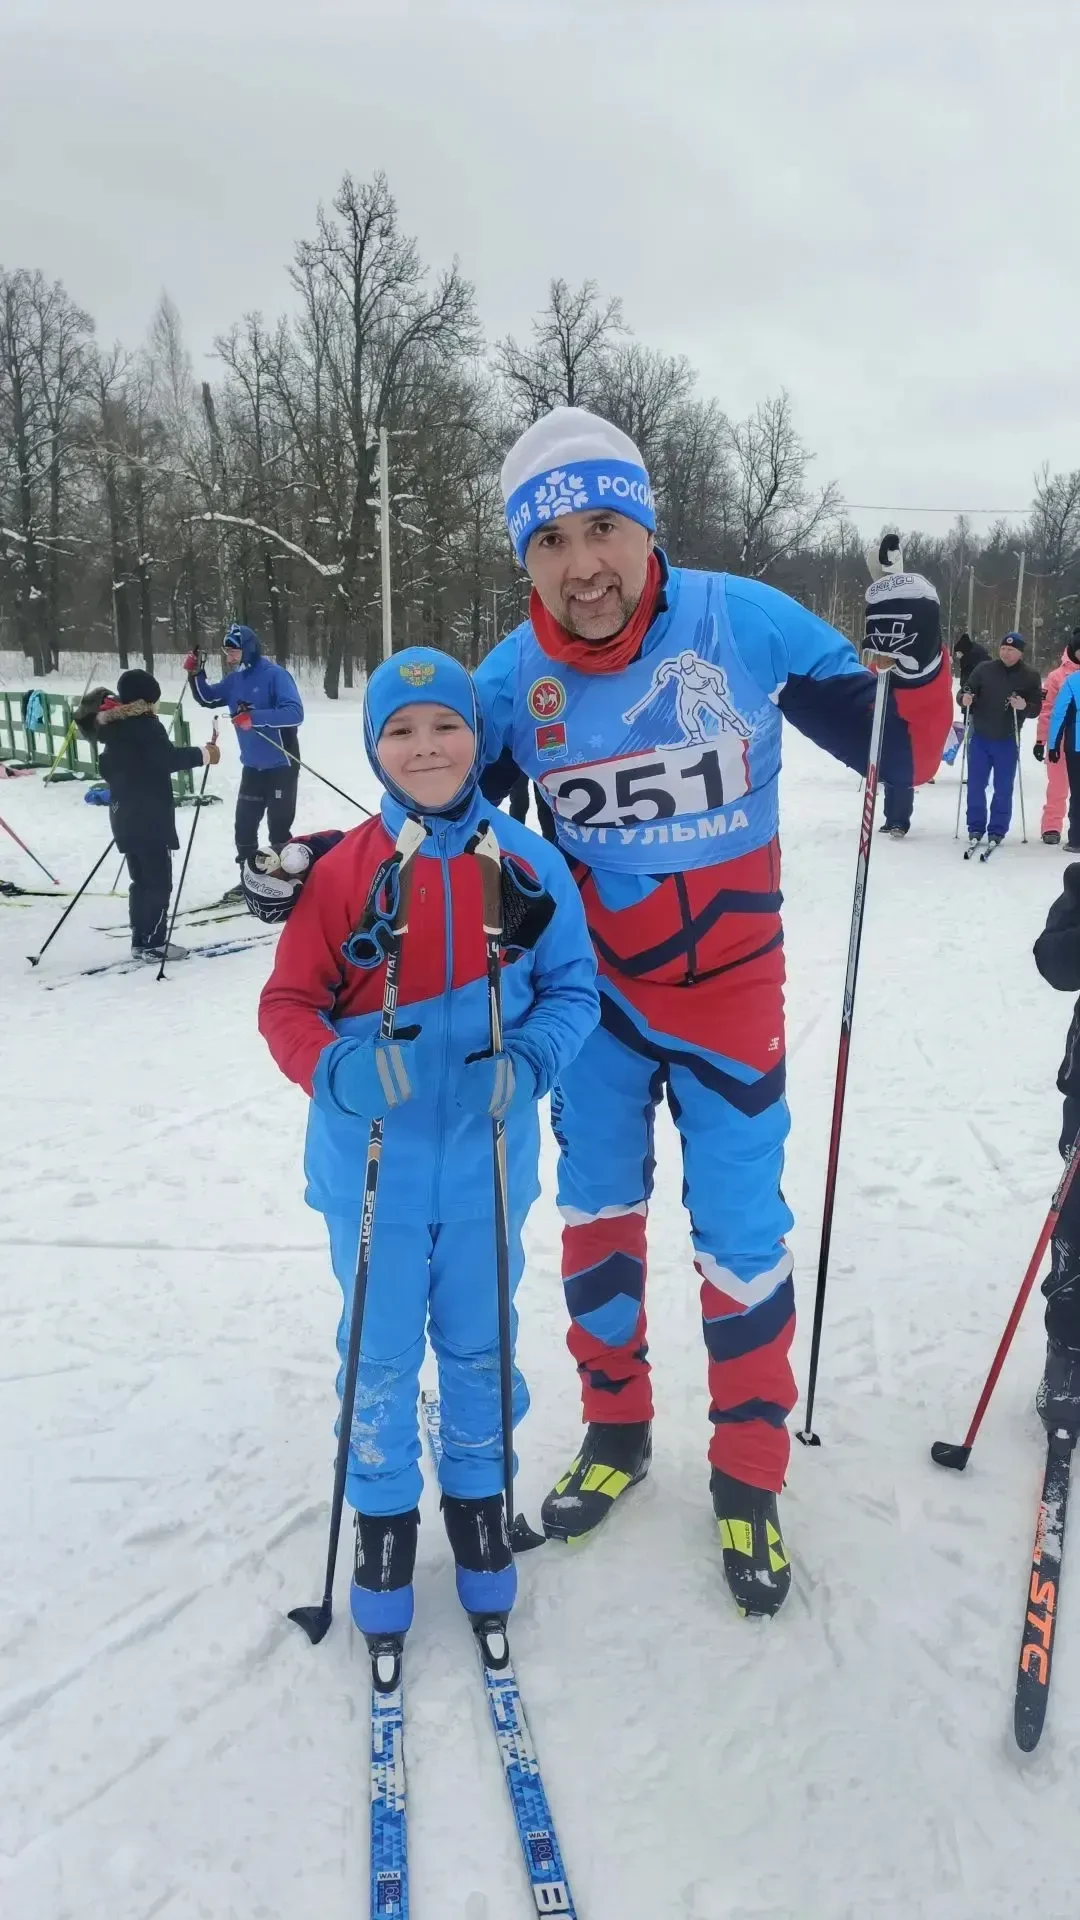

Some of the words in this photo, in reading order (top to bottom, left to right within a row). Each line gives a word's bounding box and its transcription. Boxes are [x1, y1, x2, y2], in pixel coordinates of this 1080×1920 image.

[597, 475, 655, 511] РОССИ
[557, 749, 724, 828] 251
[361, 1189, 375, 1245] SPORT
[1020, 1571, 1056, 1685] STC
[537, 1840, 552, 1860] 160
